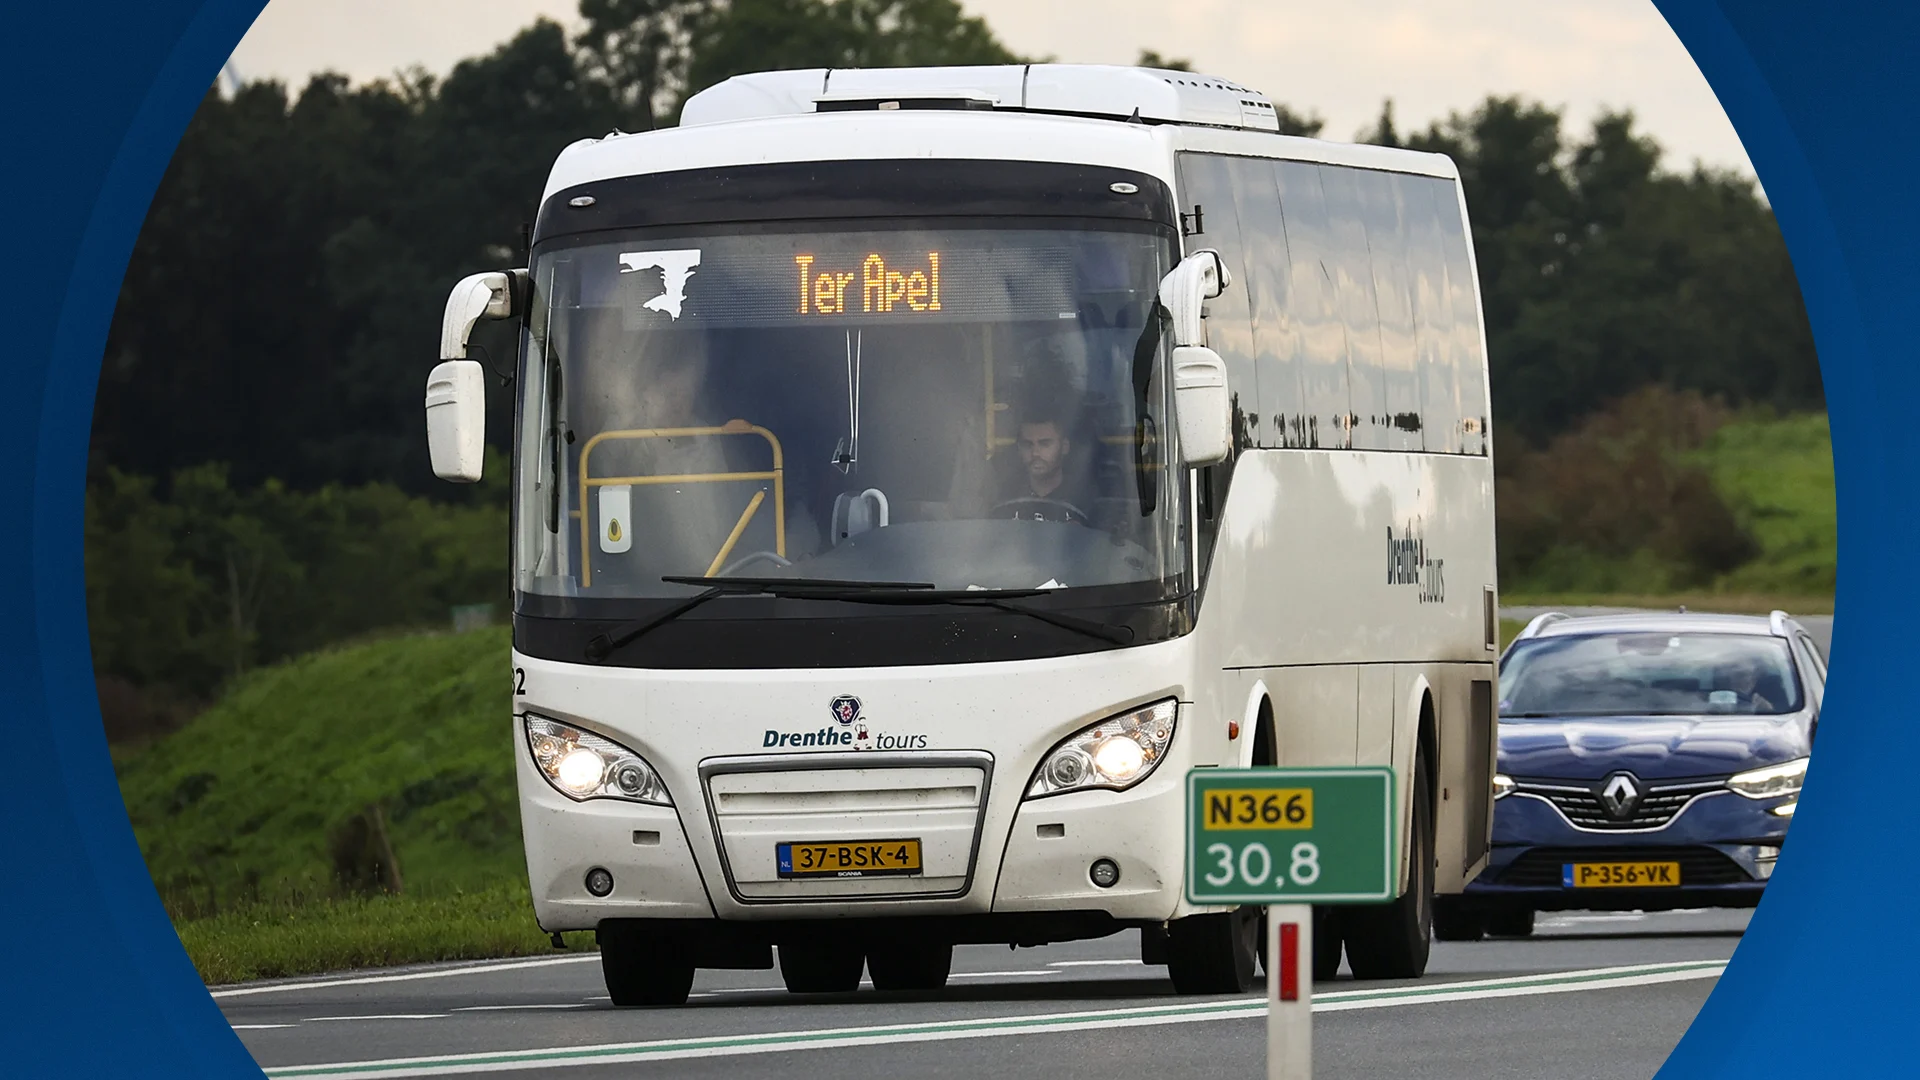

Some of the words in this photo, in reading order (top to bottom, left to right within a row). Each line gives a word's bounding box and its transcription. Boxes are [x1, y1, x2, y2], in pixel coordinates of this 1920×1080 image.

[796, 255, 854, 314] Ter
[863, 252, 941, 312] Apel
[1387, 518, 1419, 585] Drenthe
[1425, 547, 1444, 603] tours
[763, 726, 852, 747] Drenthe
[876, 733, 927, 749] tours
[1210, 794, 1305, 824] N366
[800, 845, 909, 868] 37-BSK-4
[1205, 842, 1320, 889] 30,8
[1581, 865, 1671, 883] P-356-VK
